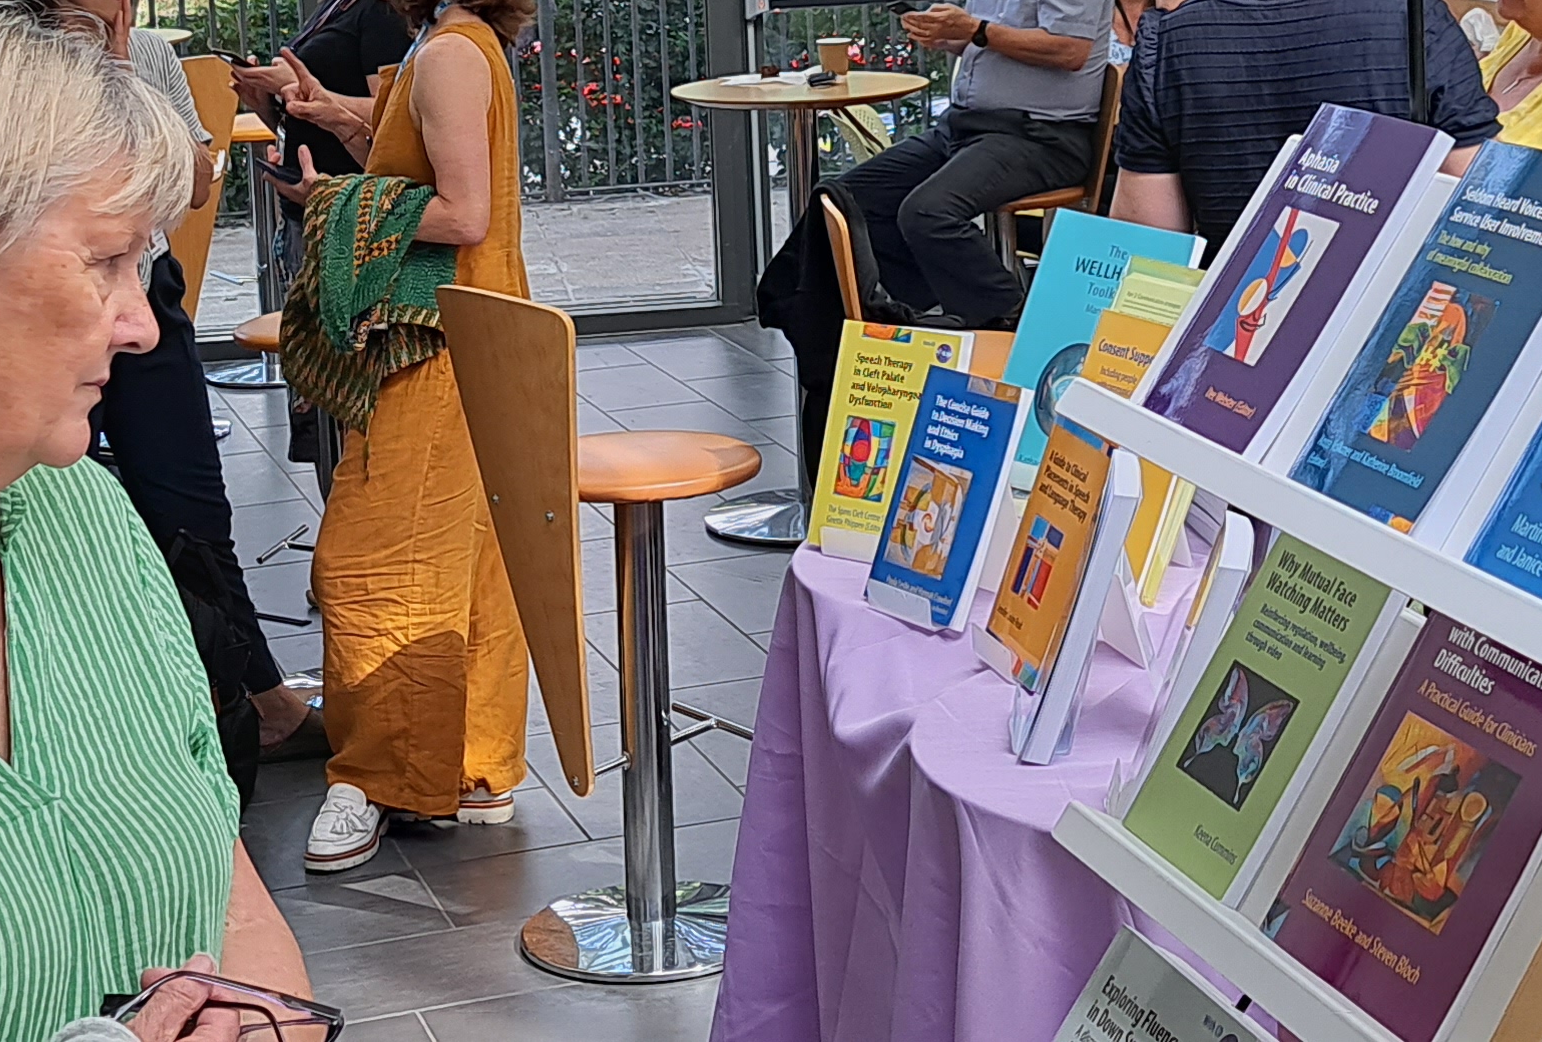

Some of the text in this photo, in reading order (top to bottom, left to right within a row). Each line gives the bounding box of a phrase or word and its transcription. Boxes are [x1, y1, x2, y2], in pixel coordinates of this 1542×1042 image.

[1297, 147, 1340, 174] Aphasia
[1284, 169, 1379, 215] in Clinical Practice
[1462, 185, 1493, 208] Seldom
[1493, 190, 1522, 212] Heard
[1449, 206, 1479, 228] Service
[1478, 213, 1502, 232] User
[1109, 244, 1127, 260] The
[856, 352, 913, 372] Speech Therapy
[1098, 338, 1130, 360] Consent
[851, 381, 866, 392] and
[863, 369, 906, 384] Cleft Palate
[848, 395, 893, 411] Dysfunction
[1495, 544, 1514, 564] and
[1277, 549, 1358, 608] Why Mutual Face
[1265, 570, 1351, 633] Watching Matters
[1447, 625, 1476, 654] with
[1433, 648, 1497, 696] Difficulties
[1426, 682, 1539, 759] Practical Guide for Clinicians
[1301, 887, 1422, 986] Suzanne Beeke Steven Bloch
[1101, 973, 1145, 1028] Exploring
[1086, 999, 1125, 1042] in Down
